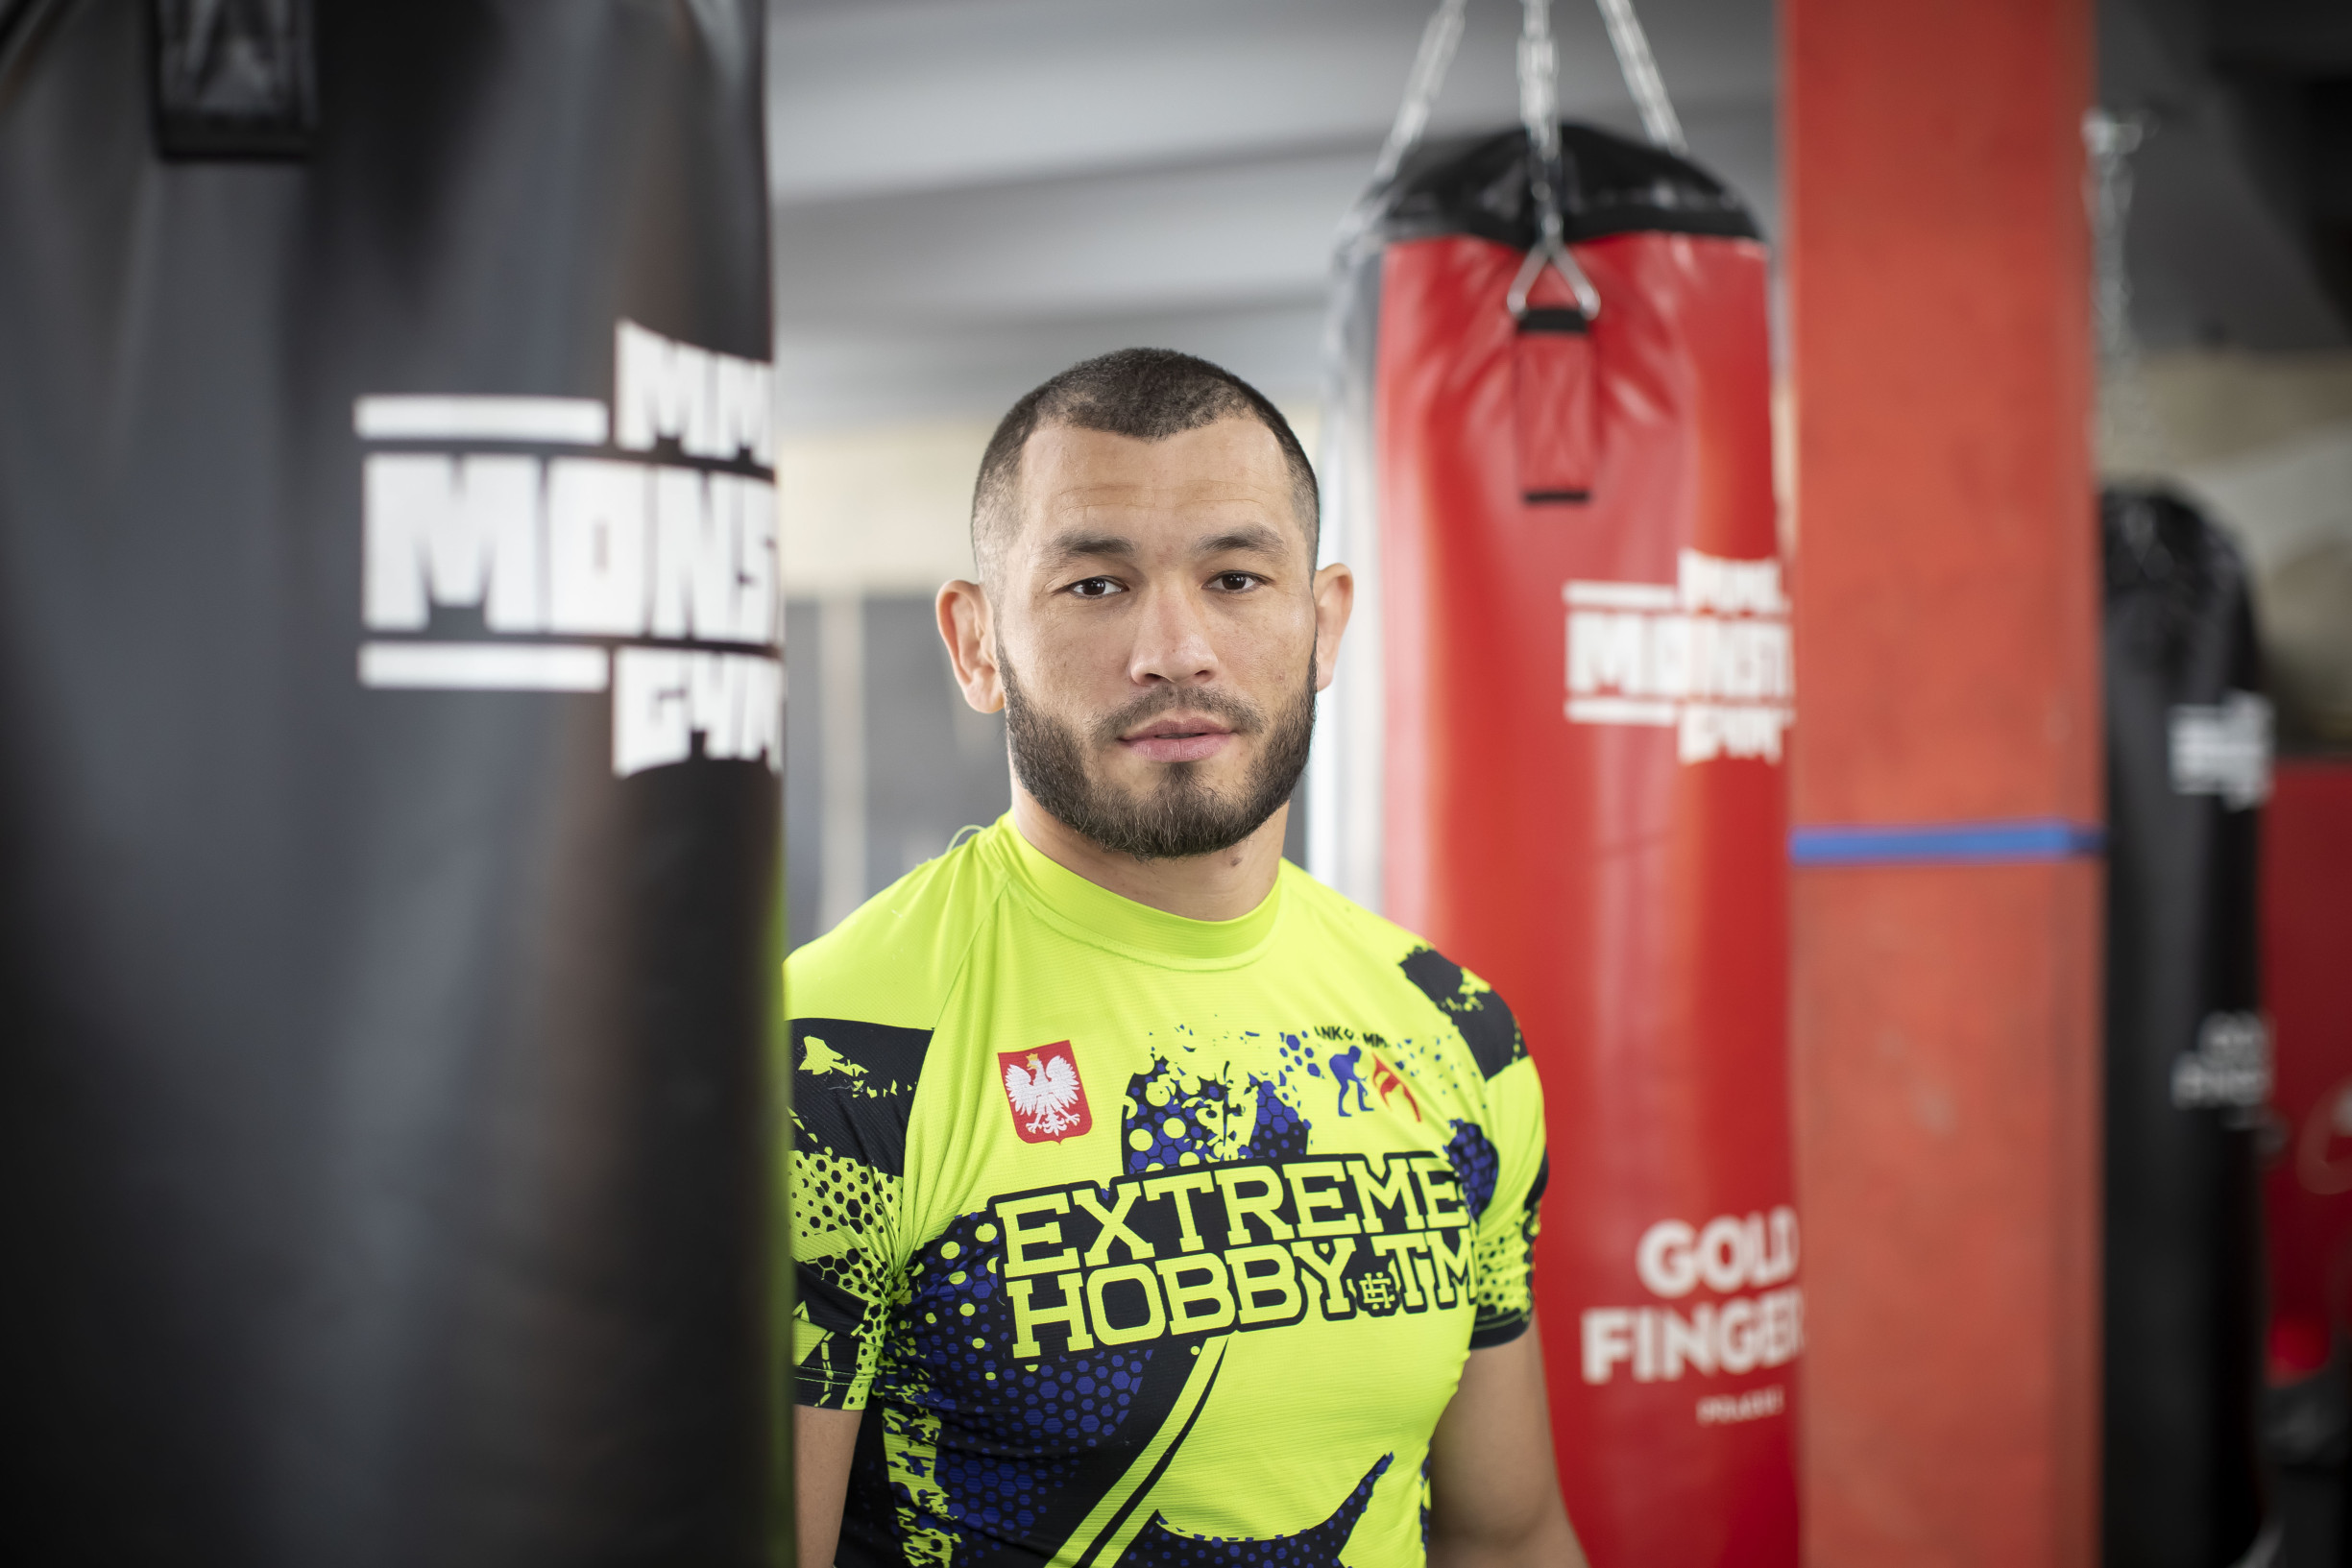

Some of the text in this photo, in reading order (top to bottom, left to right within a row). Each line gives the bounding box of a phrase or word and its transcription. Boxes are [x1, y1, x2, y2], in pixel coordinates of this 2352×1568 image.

[615, 319, 776, 467] MM
[363, 452, 781, 645] MONS
[995, 1158, 1470, 1278] EXTREME
[1580, 1285, 1804, 1385] FINGE
